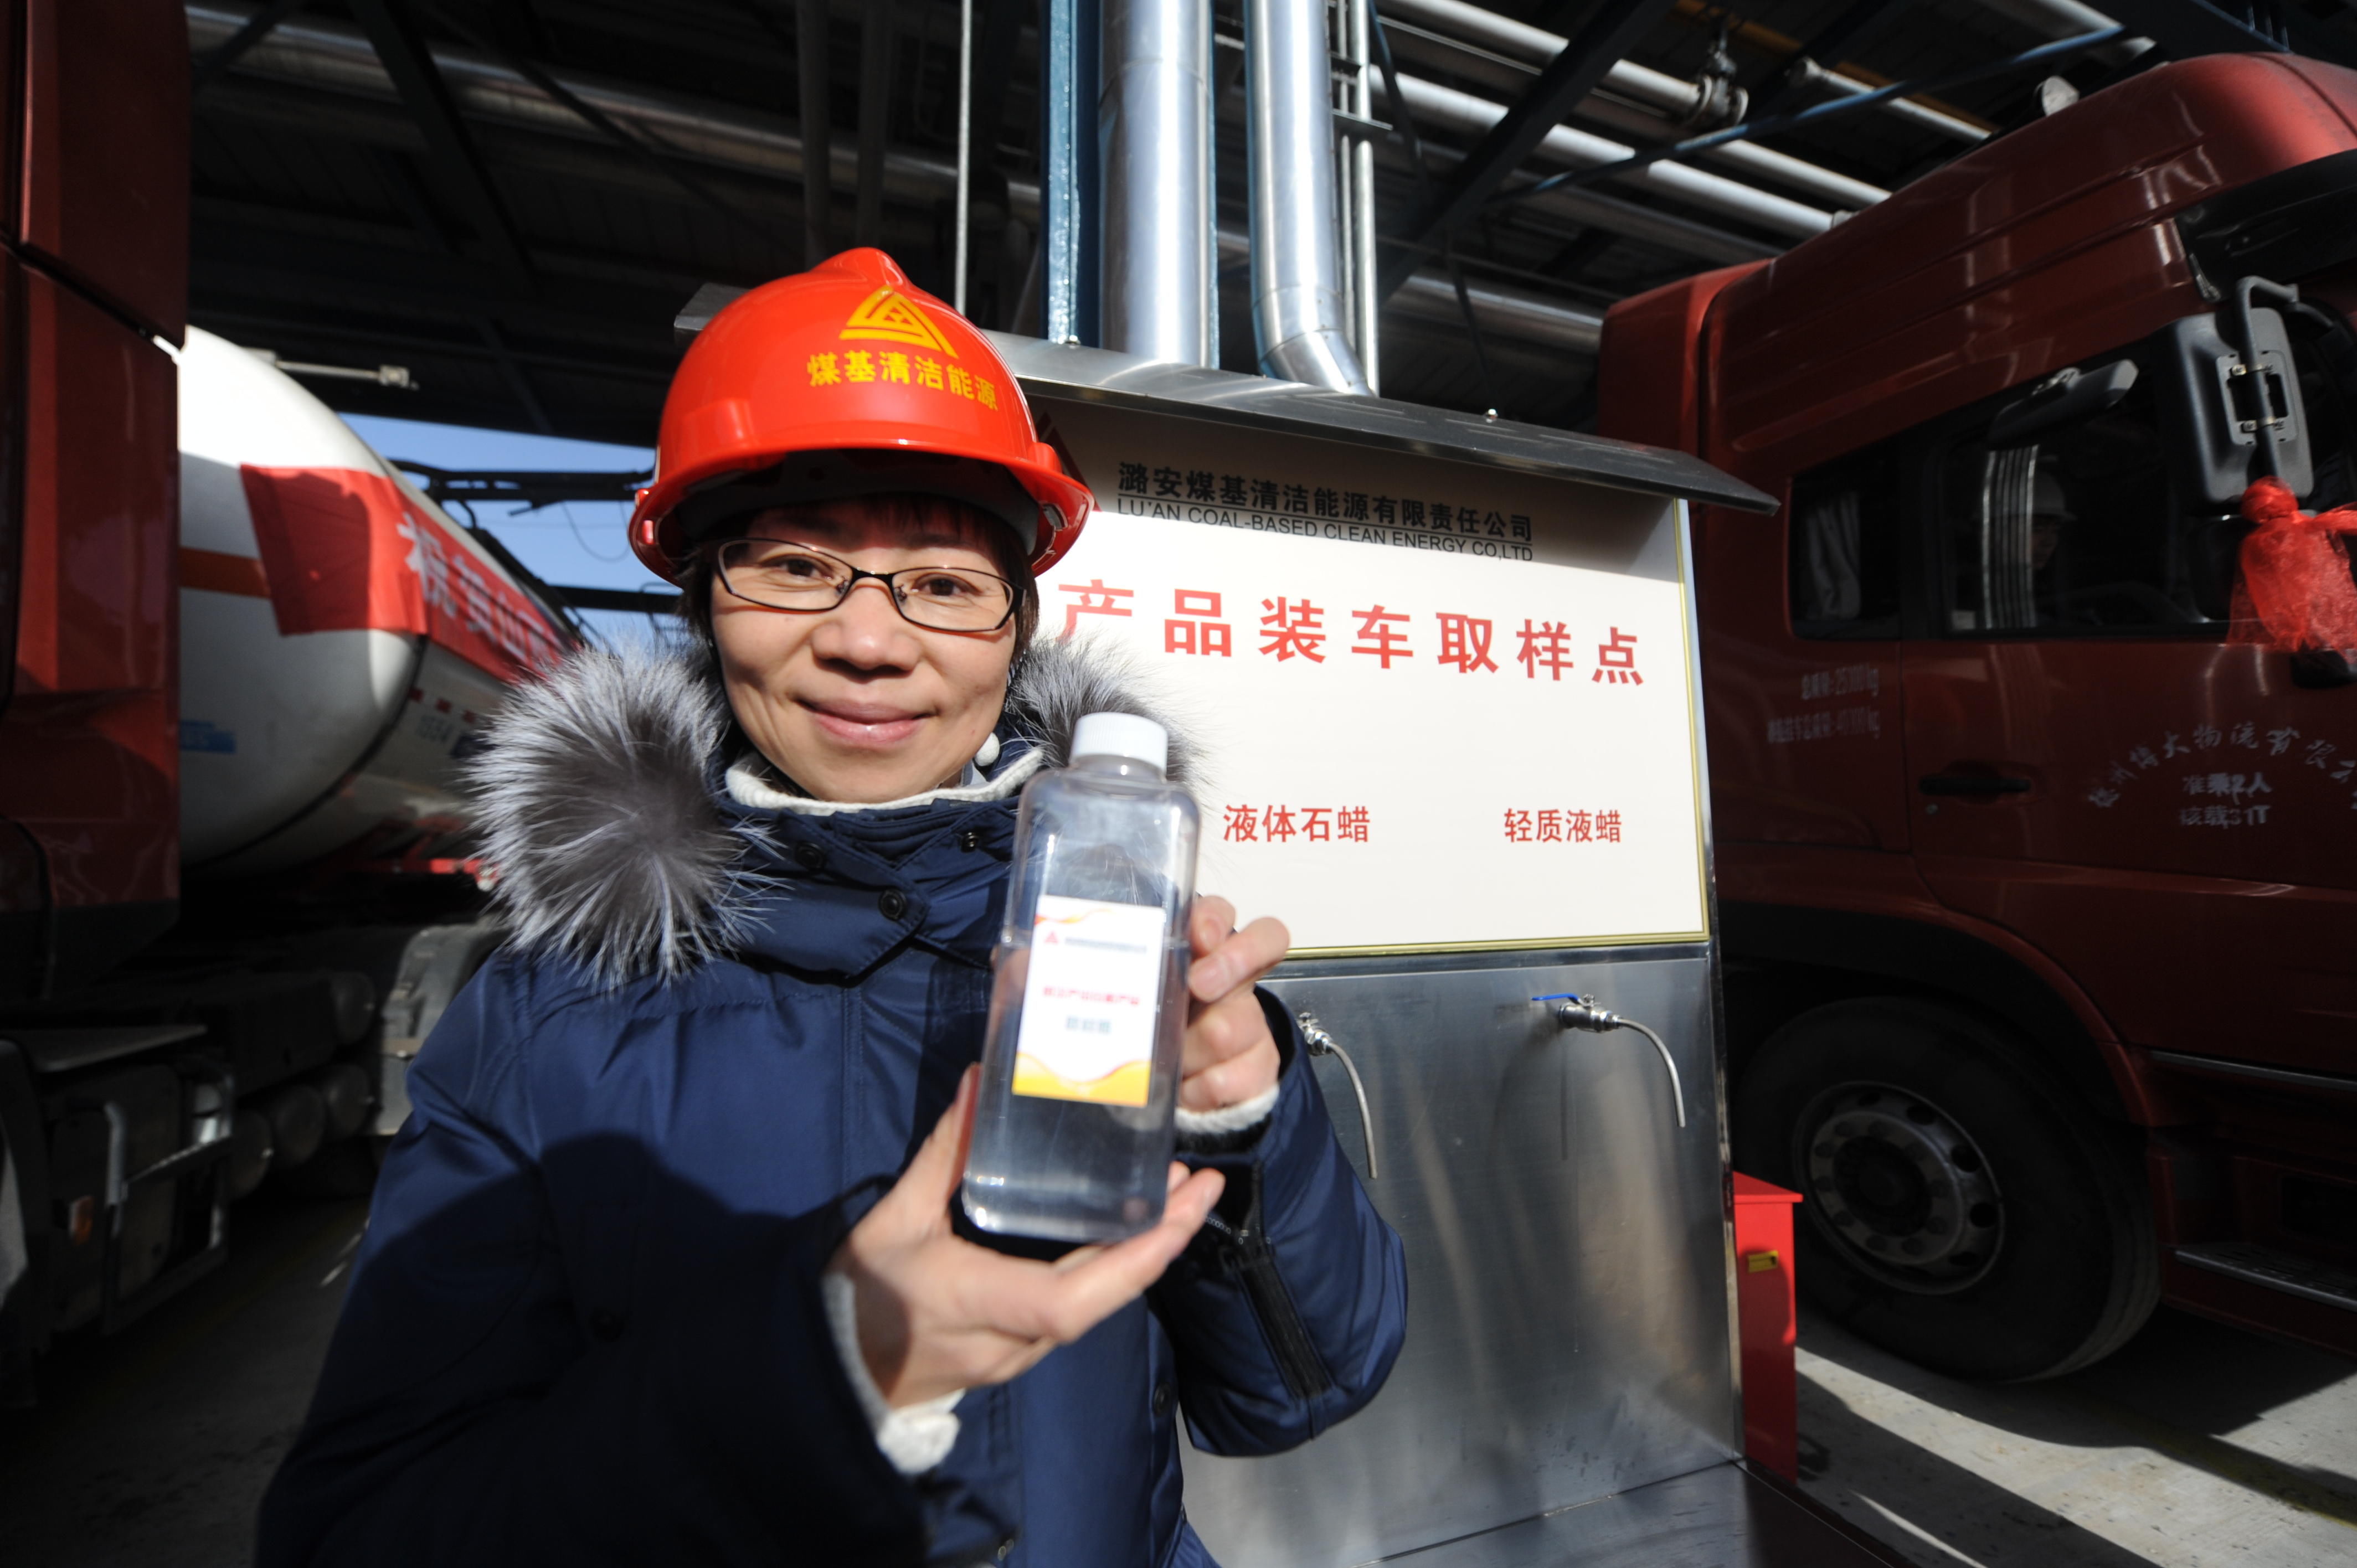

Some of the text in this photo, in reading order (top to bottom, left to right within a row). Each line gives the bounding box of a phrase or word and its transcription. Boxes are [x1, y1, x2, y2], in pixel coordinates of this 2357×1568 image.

[807, 350, 997, 410] 煤基清洁能源
[1118, 462, 1532, 542] 潞安煤基清洁能源有限责任公司
[1188, 507, 1318, 538] COAL-BASED
[1323, 524, 1386, 546] CLEAN
[1392, 531, 1466, 554] ENERGY
[1058, 579, 1644, 685] 产品装车取样点
[1223, 804, 1370, 843] 液体石蜡
[1504, 807, 1622, 843] 轻质液蜡
